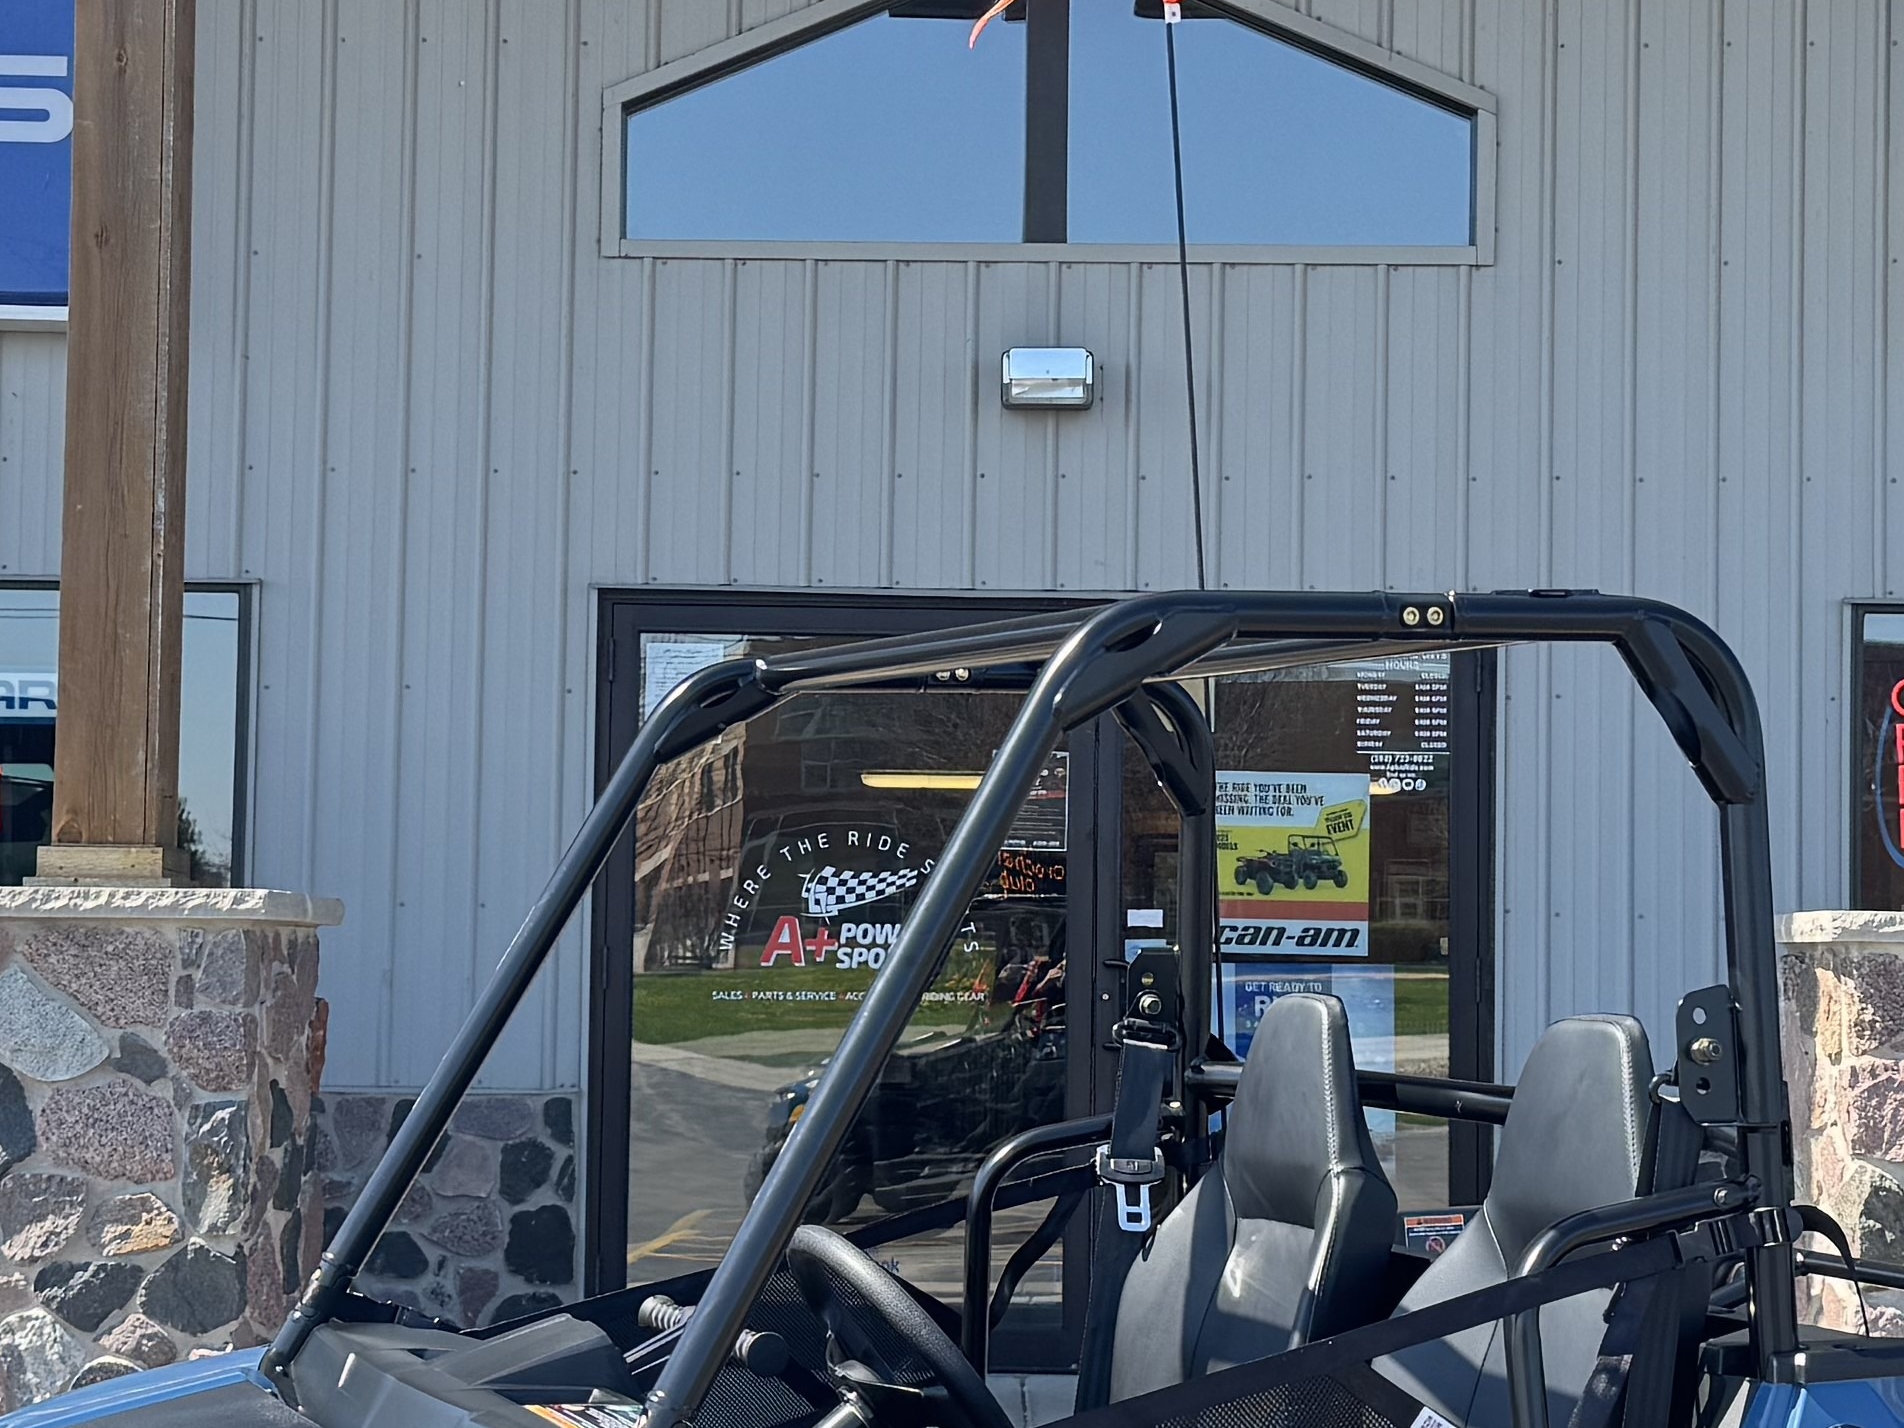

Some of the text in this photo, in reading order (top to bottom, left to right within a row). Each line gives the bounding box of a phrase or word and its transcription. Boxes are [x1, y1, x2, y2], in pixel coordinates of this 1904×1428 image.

[719, 863, 772, 951] WHERE
[779, 832, 830, 862] THE
[848, 830, 910, 859] RIDE
[760, 915, 838, 967] A+
[840, 923, 901, 945] POW
[1220, 925, 1360, 948] can-am
[836, 947, 886, 969] SPO
[712, 990, 743, 1001] SALES
[752, 990, 785, 1001] PARTS
[795, 991, 836, 1001] SERVICE
[1245, 981, 1322, 993] GET READY TO
